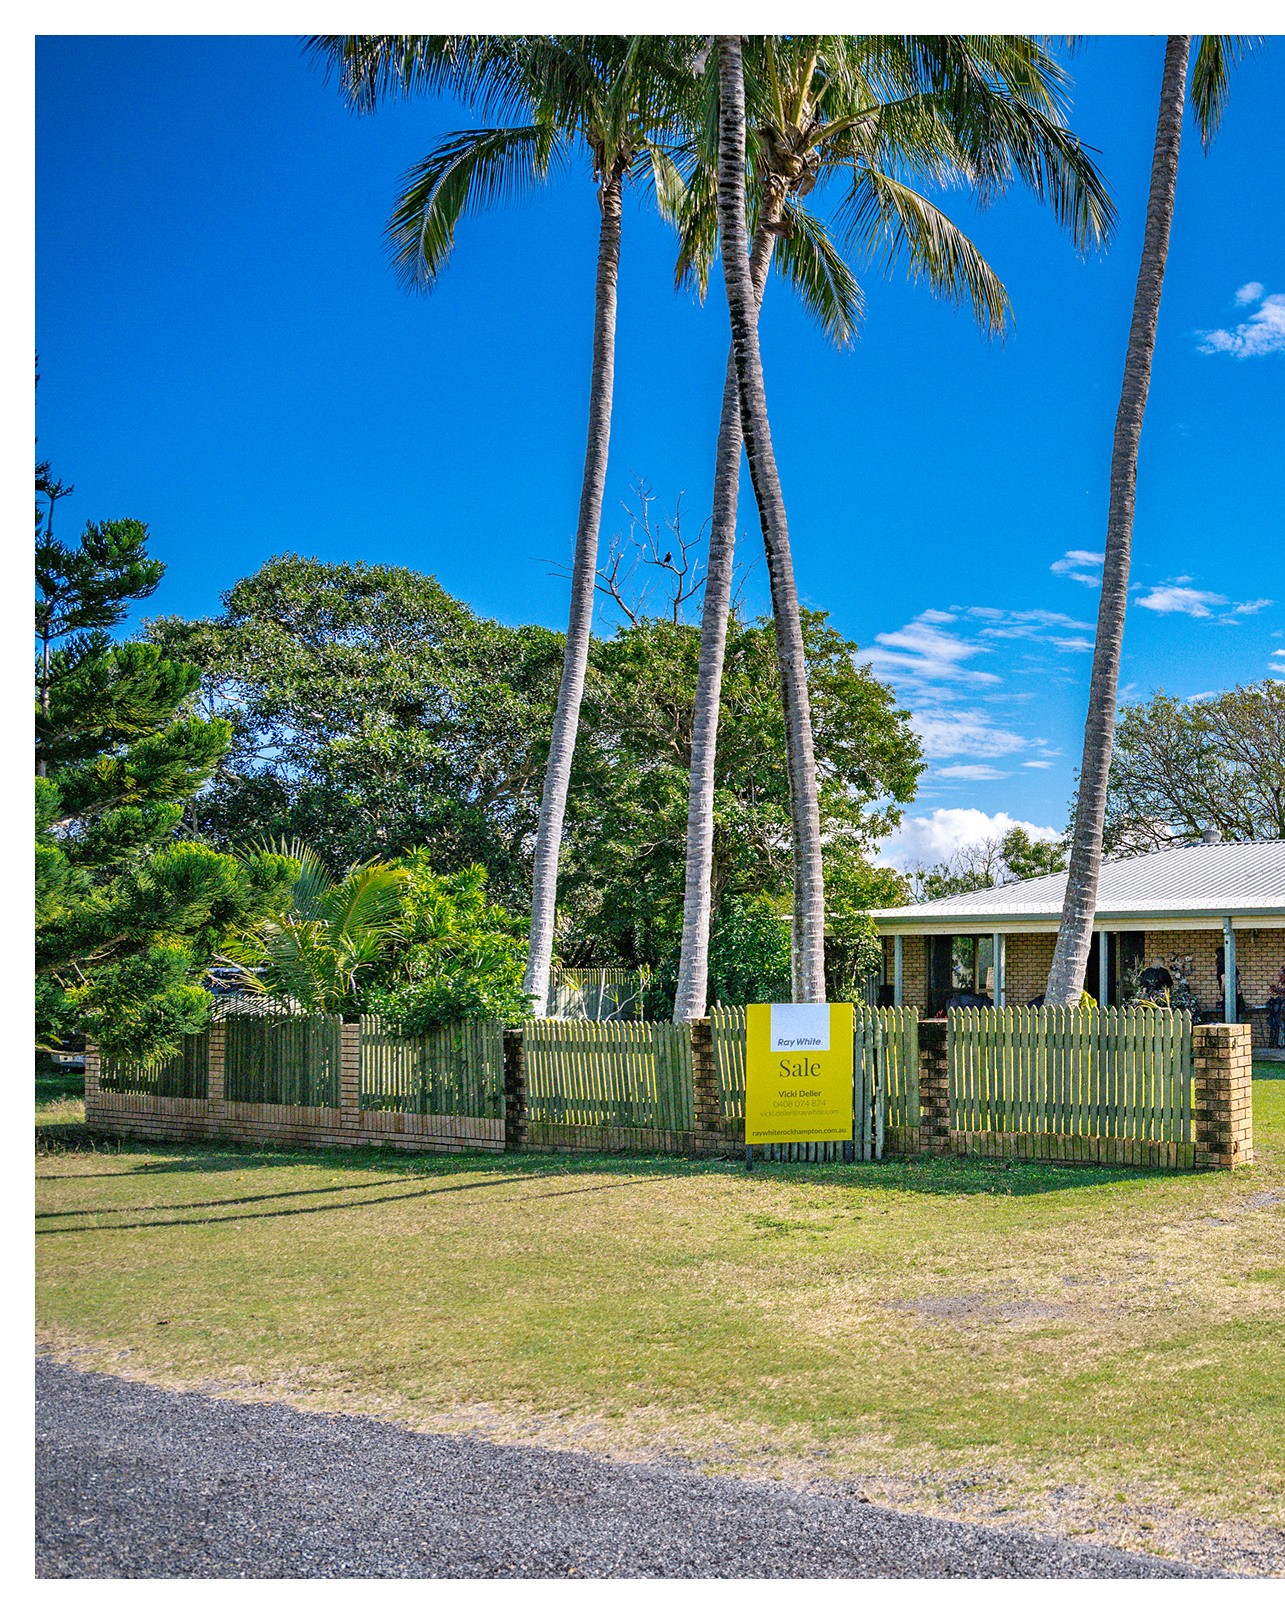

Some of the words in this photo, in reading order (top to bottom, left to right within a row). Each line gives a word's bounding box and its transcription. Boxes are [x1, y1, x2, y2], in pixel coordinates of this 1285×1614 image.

[777, 1038, 796, 1048] Ray
[796, 1038, 822, 1046] White
[779, 1058, 821, 1078] Sale
[778, 1090, 798, 1098] Vicki
[799, 1090, 822, 1098] Deller
[772, 1100, 793, 1108] 0408
[752, 1128, 847, 1137] raywhiterockhampton.com.au
